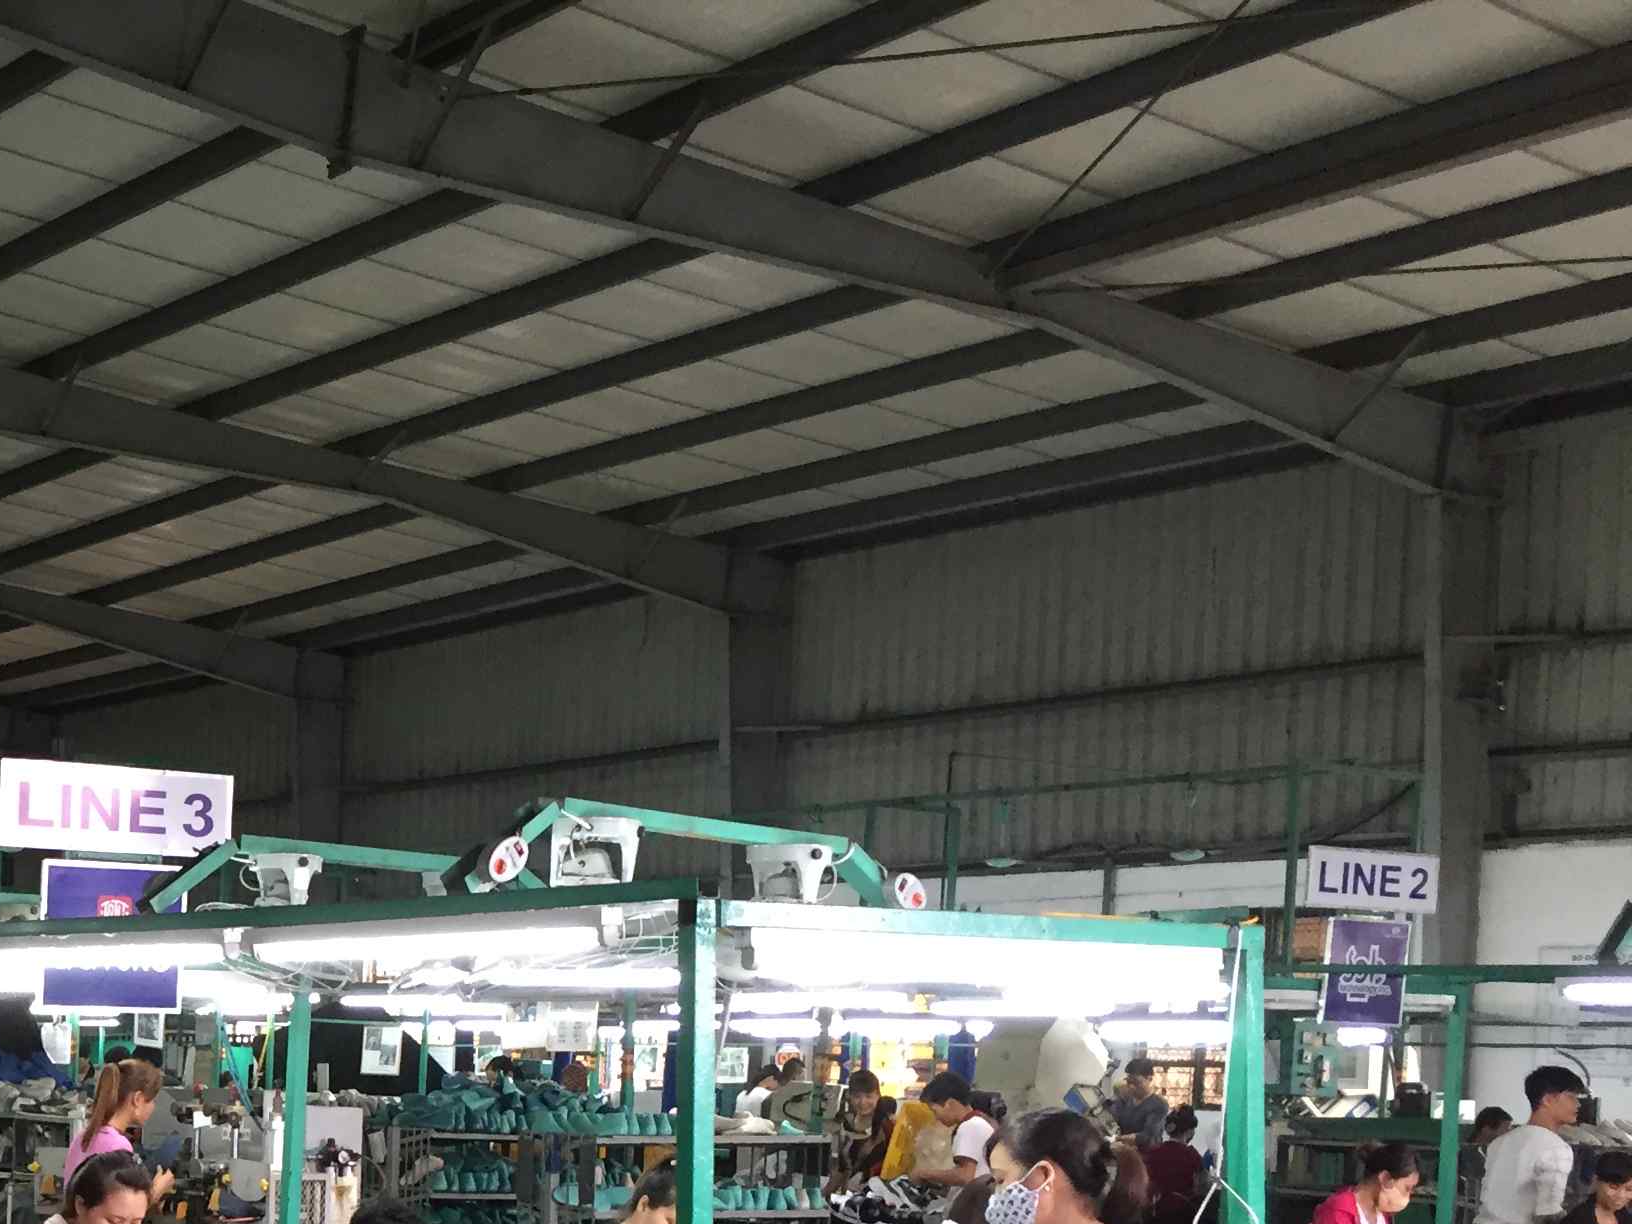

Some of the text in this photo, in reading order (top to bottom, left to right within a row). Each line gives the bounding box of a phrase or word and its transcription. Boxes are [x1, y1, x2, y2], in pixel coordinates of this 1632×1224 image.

[18, 781, 214, 838] LINE 3
[1318, 861, 1428, 900] LINE 2
